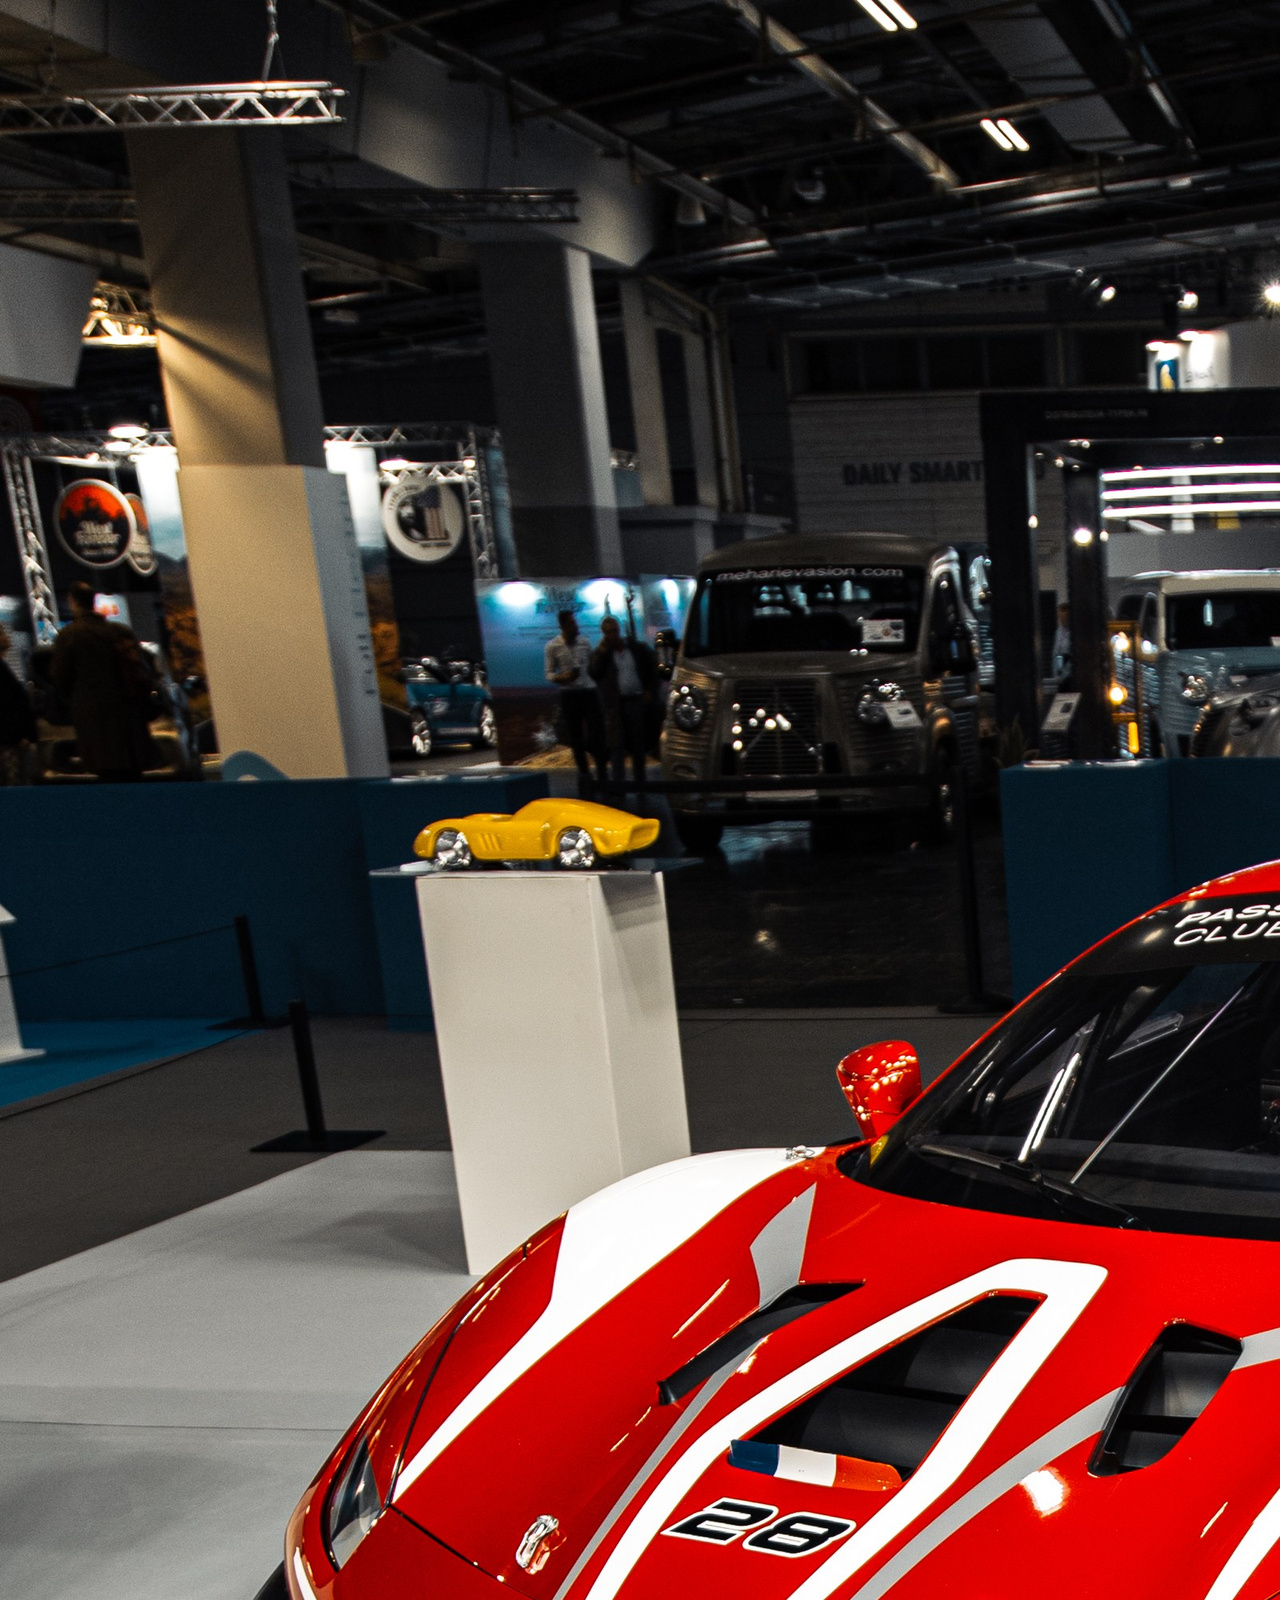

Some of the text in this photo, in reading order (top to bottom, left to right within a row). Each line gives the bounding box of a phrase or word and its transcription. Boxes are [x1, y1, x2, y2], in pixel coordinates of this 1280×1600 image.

[842, 461, 902, 485] DAILY
[715, 565, 904, 582] meharievasion.com
[660, 1496, 857, 1559] 28
